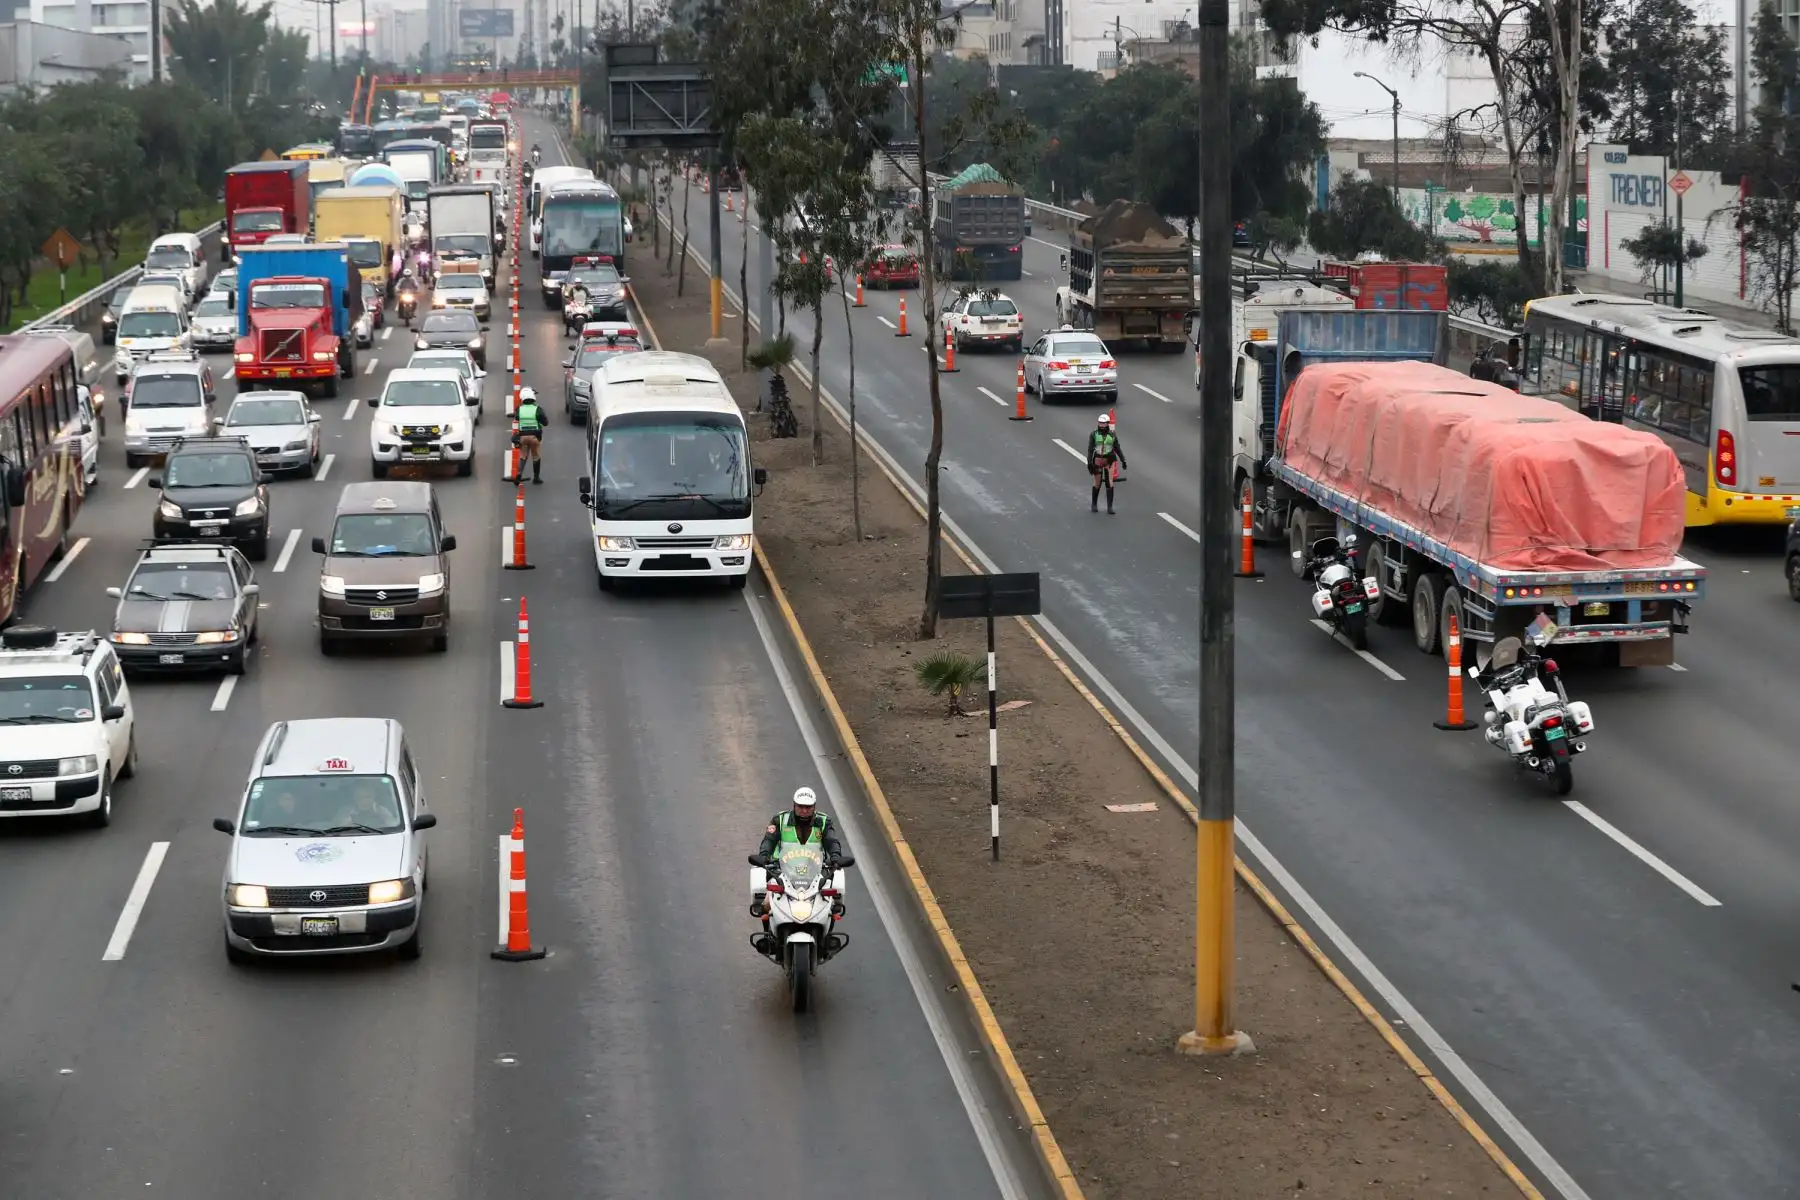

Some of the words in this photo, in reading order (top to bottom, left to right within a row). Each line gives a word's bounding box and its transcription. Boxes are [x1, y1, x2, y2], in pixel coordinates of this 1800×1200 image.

[1609, 173, 1662, 207] TRENER
[326, 760, 348, 768] TAXI
[782, 849, 820, 865] POLICIA
